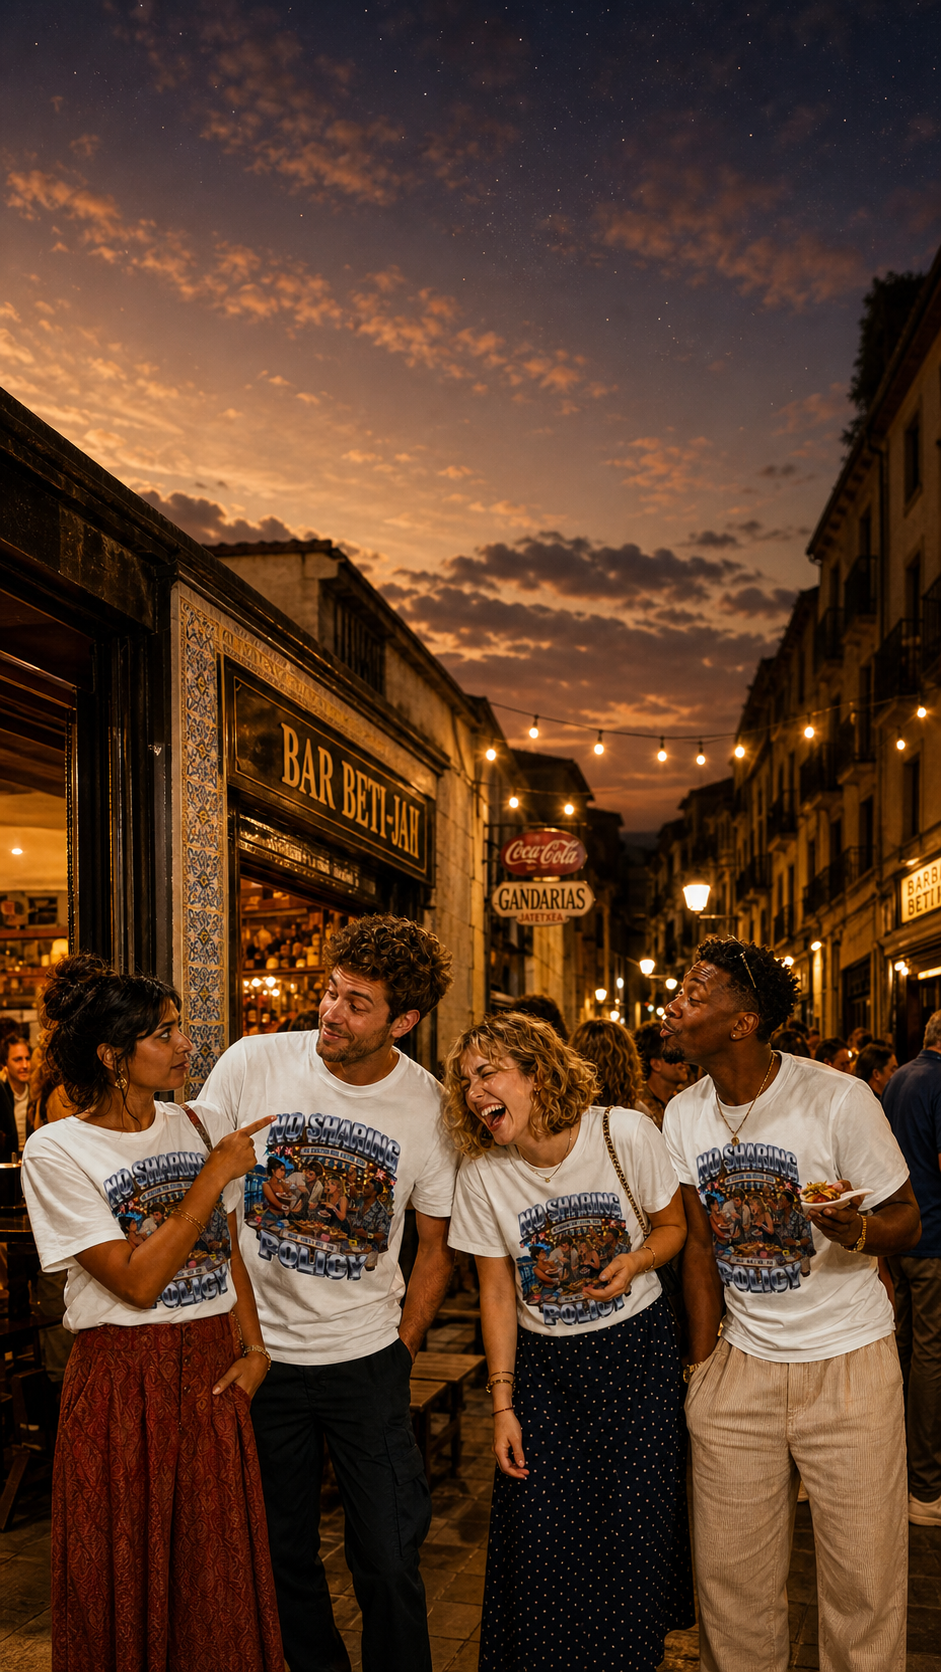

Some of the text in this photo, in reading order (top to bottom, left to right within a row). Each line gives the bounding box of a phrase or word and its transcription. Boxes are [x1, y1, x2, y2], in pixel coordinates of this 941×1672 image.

[280, 722, 420, 859] BAR BETI-JAH
[505, 839, 580, 865] Coca-Cola
[498, 888, 586, 911] GANDARIAS
[908, 866, 941, 896] BARB
[266, 1112, 306, 1145] NO
[306, 1112, 402, 1175] SHARING
[696, 1143, 800, 1185] NO SHARING
[103, 1168, 136, 1209] NO
[517, 1203, 546, 1239] NO
[545, 1192, 623, 1222] SHARING
[257, 1230, 367, 1280] POLICY
[152, 1263, 229, 1309] OLICY
[716, 1259, 801, 1294] POLICY
